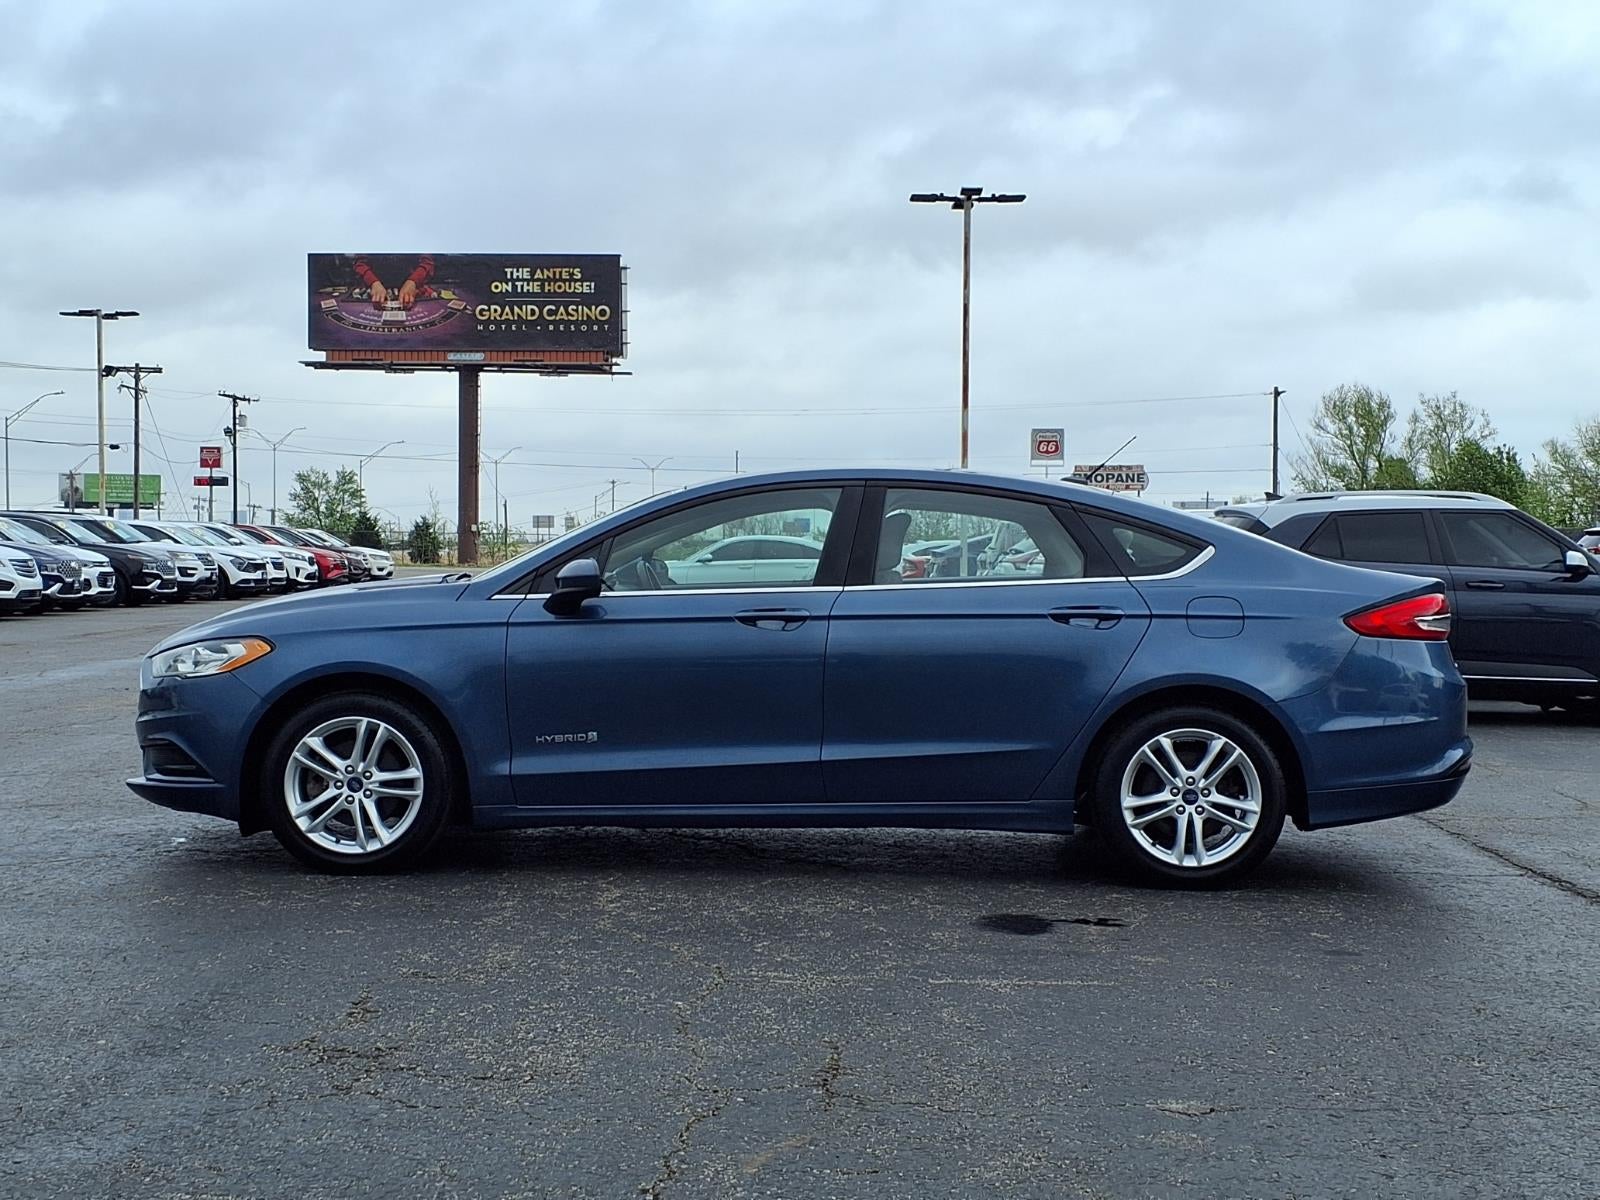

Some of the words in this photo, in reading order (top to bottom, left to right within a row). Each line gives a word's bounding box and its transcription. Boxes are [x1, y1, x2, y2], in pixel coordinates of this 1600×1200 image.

[505, 268, 531, 279] THE
[534, 268, 582, 279] ANTE'S
[491, 282, 512, 293] ON
[515, 282, 541, 293] THE
[544, 282, 595, 293] HOUSE!
[475, 304, 540, 320] GRAND
[542, 304, 611, 321] CASINO
[1039, 441, 1057, 452] 66
[535, 733, 587, 743] HYBRID
